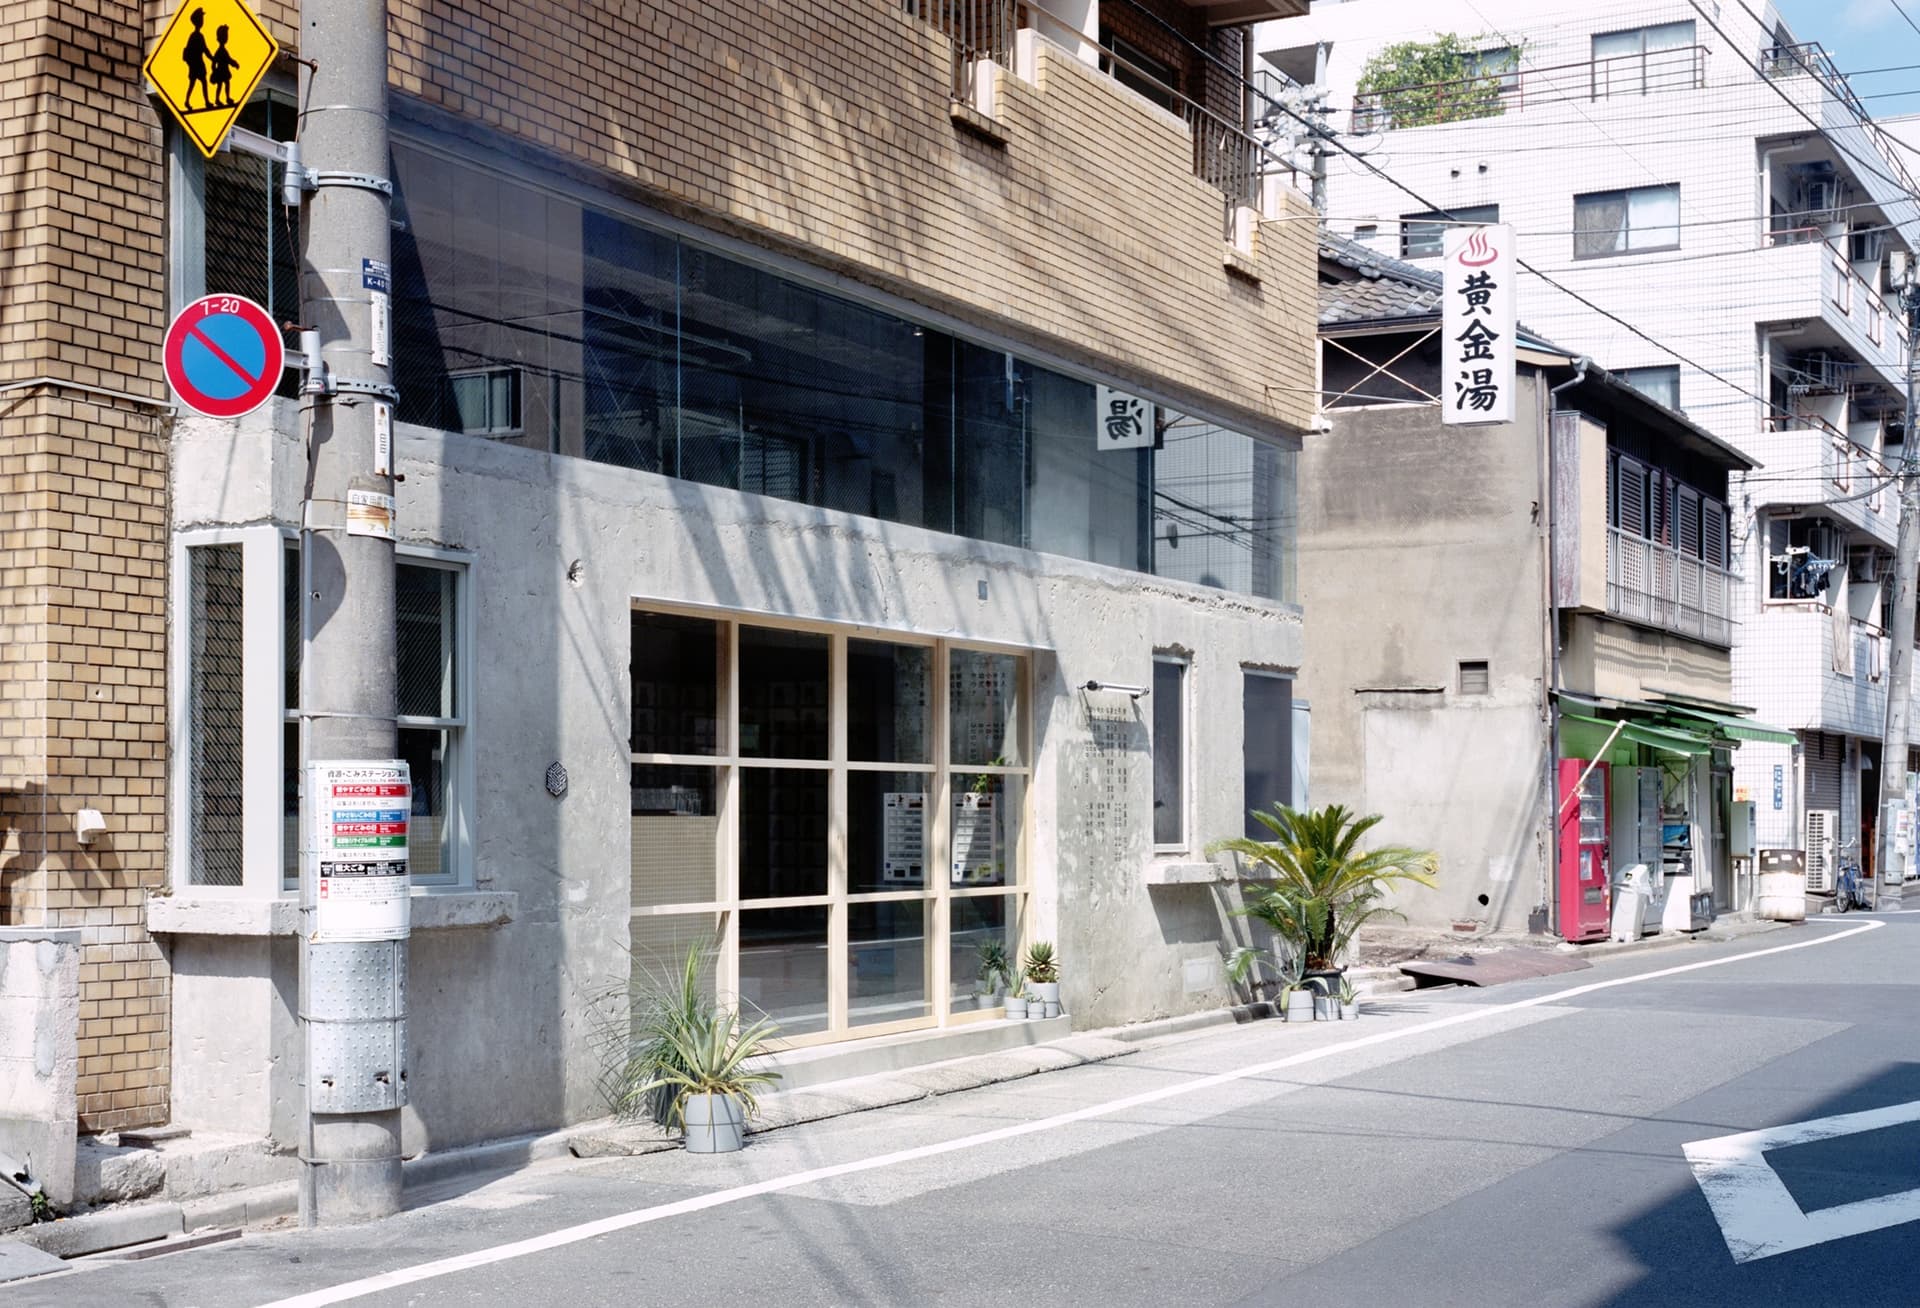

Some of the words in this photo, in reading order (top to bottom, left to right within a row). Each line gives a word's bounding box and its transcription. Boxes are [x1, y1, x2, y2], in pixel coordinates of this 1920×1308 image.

[200, 298, 240, 316] 7-20
[1454, 270, 1500, 412] 黄金湯
